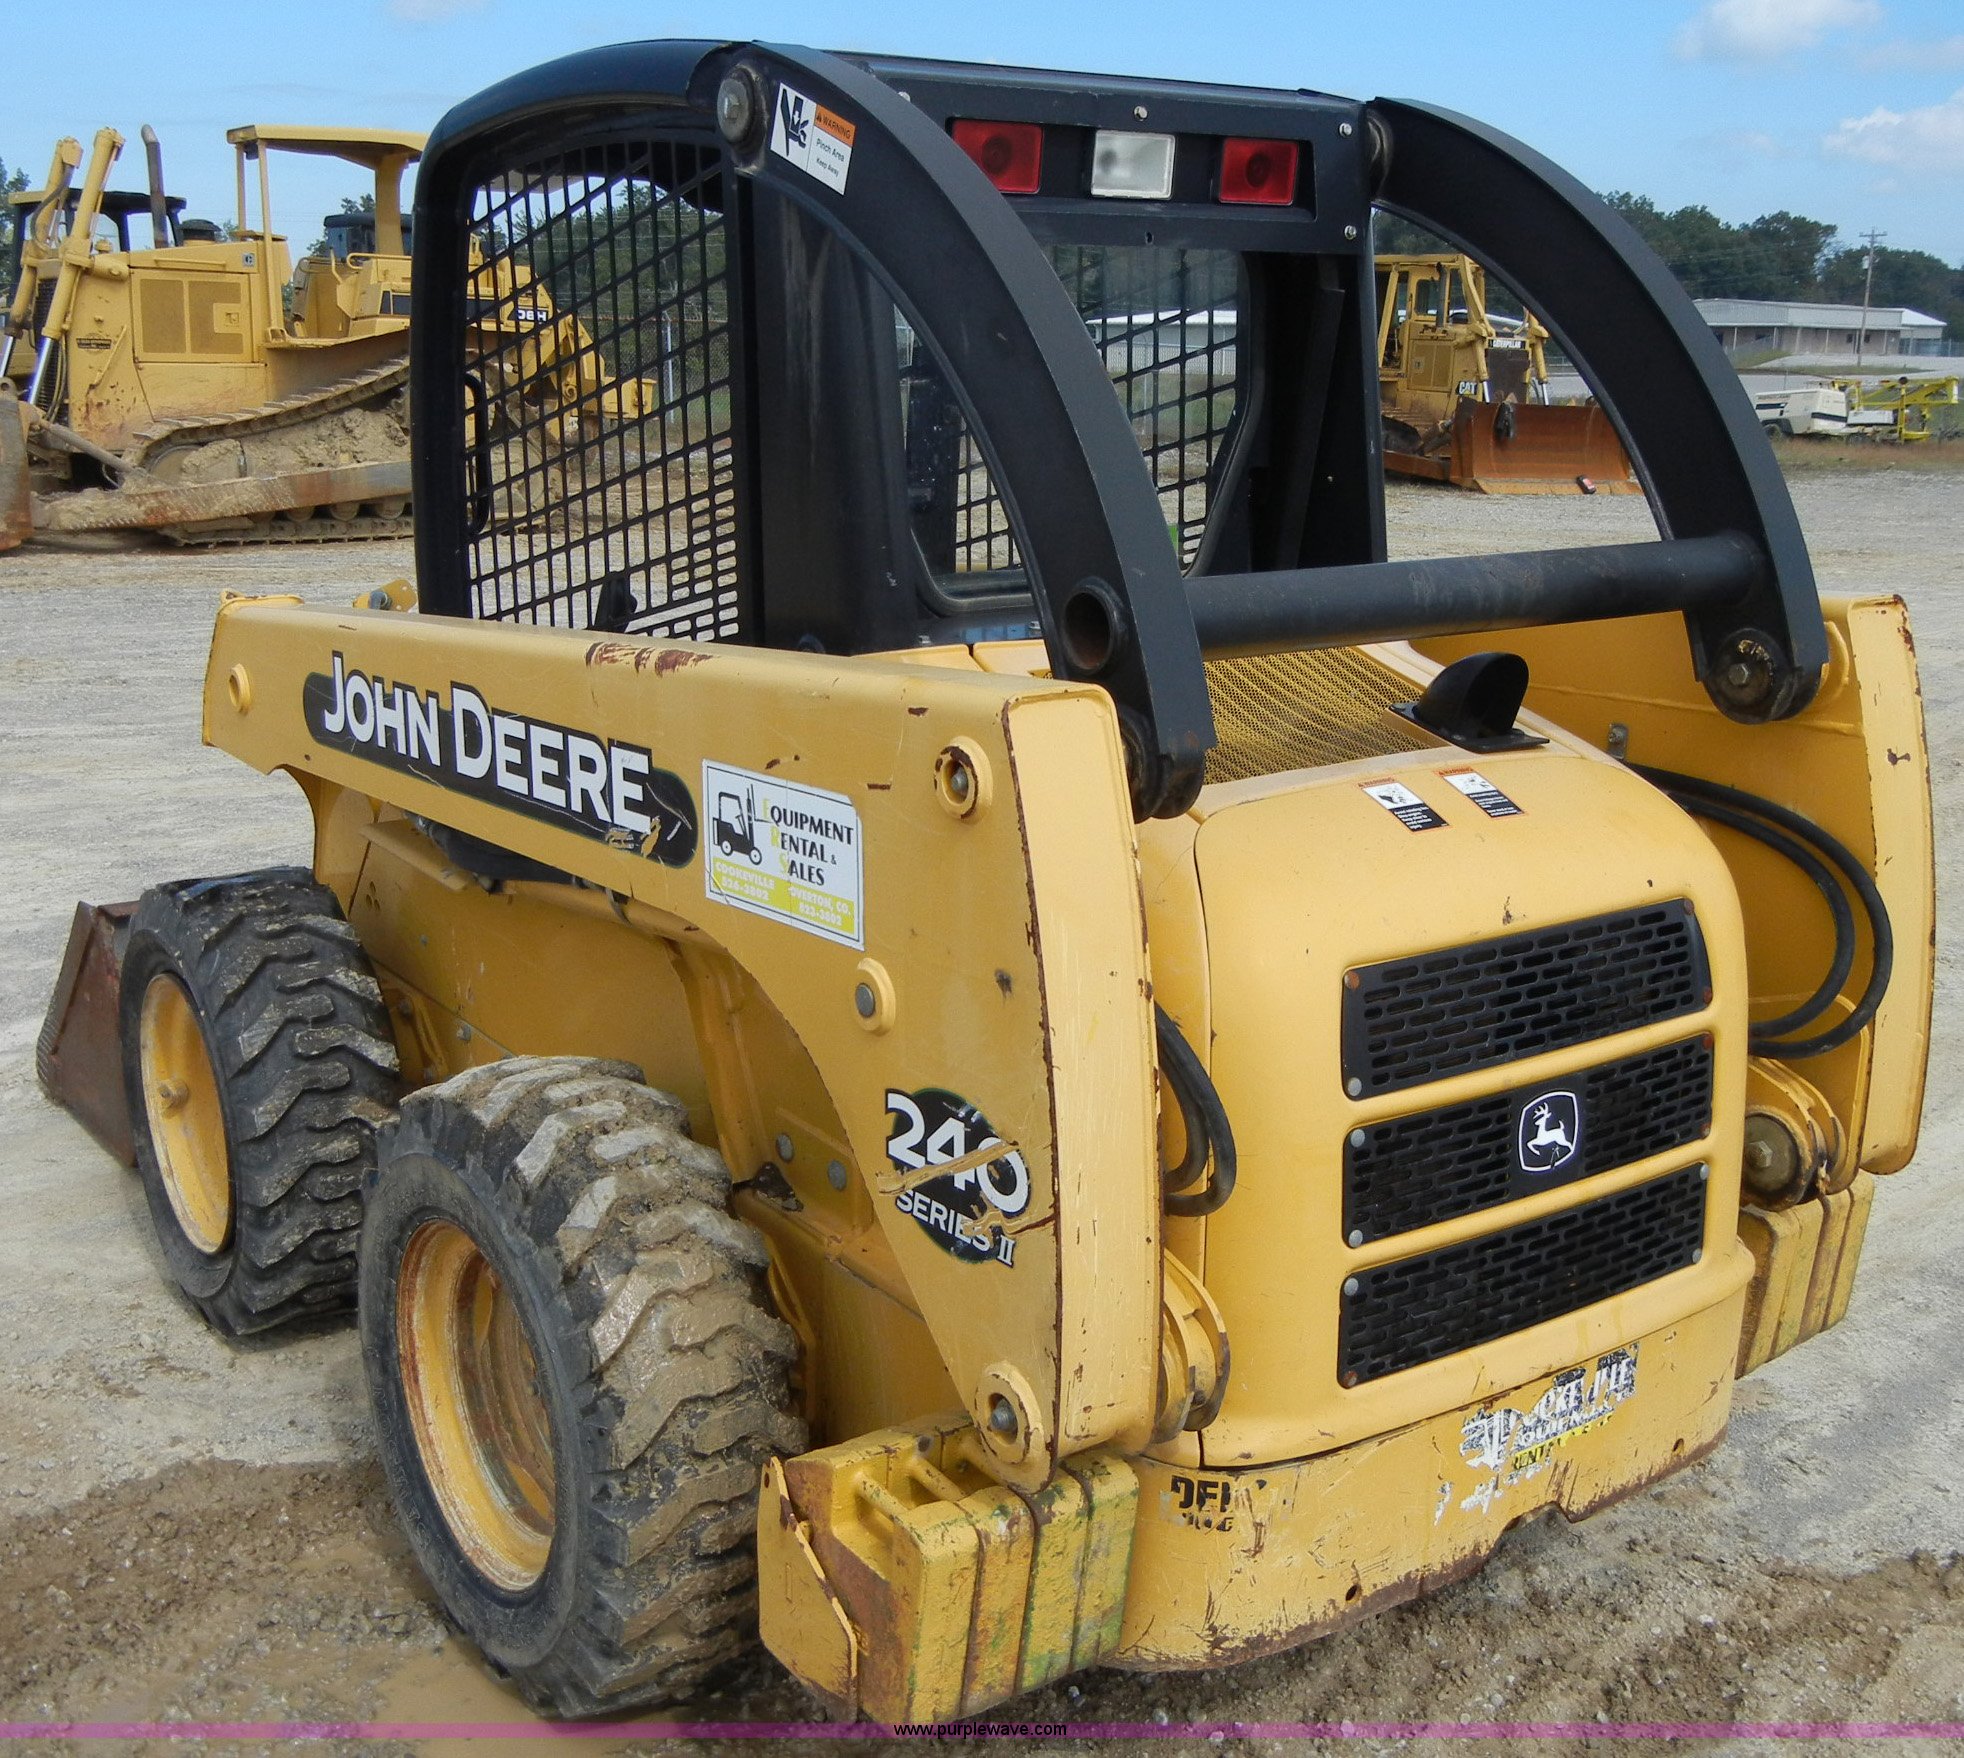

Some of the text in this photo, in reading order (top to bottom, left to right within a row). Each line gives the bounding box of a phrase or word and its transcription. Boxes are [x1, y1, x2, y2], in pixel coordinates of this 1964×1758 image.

[821, 117, 851, 139] WARNING
[816, 138, 845, 162] Pinch Area
[816, 158, 839, 178] Keep Away
[1459, 380, 1477, 395] CAT
[324, 656, 650, 834] JOHN DEERE
[762, 797, 854, 845] EQUIPMENT
[770, 825, 828, 864] RENTAL
[716, 861, 775, 889] COOKEVILLE
[778, 852, 825, 886] SALES
[887, 1092, 1029, 1213] 240
[997, 1234, 1015, 1266] II
